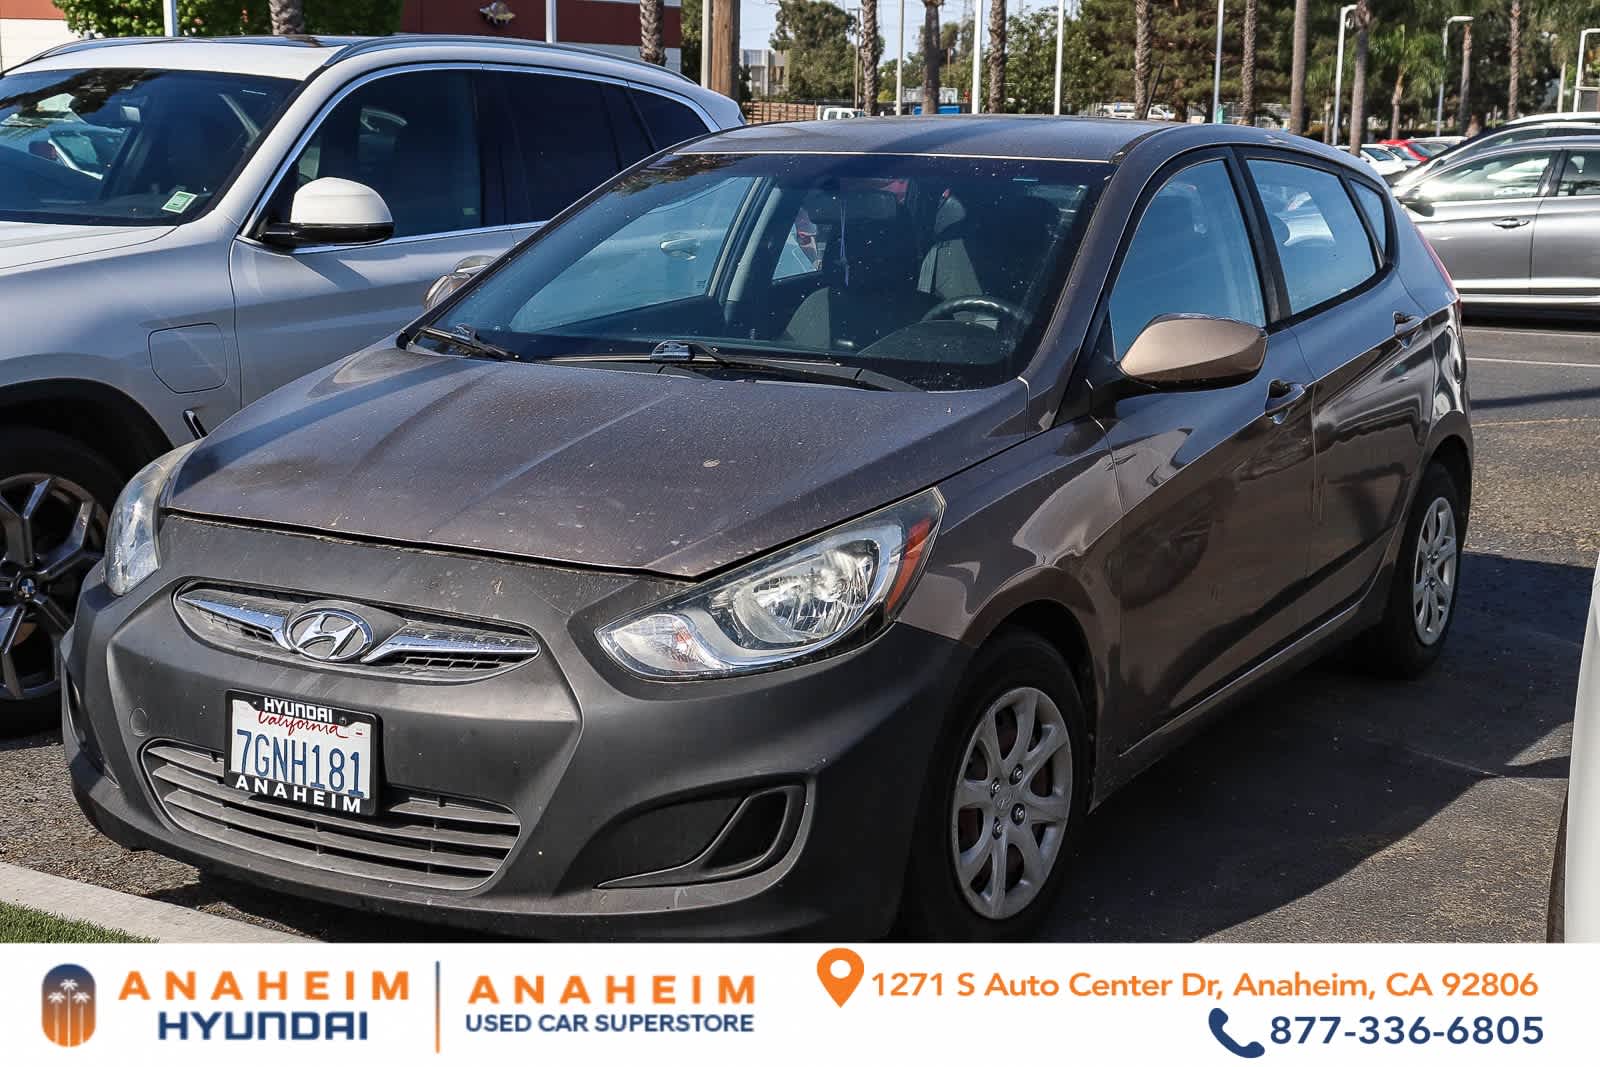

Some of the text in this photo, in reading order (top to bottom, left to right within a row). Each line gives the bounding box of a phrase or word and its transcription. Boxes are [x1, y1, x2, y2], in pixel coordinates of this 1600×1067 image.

[257, 709, 348, 738] California
[264, 697, 333, 723] HYUNDAI
[236, 729, 365, 798] 7GNH181
[235, 775, 361, 814] ANAHEIM
